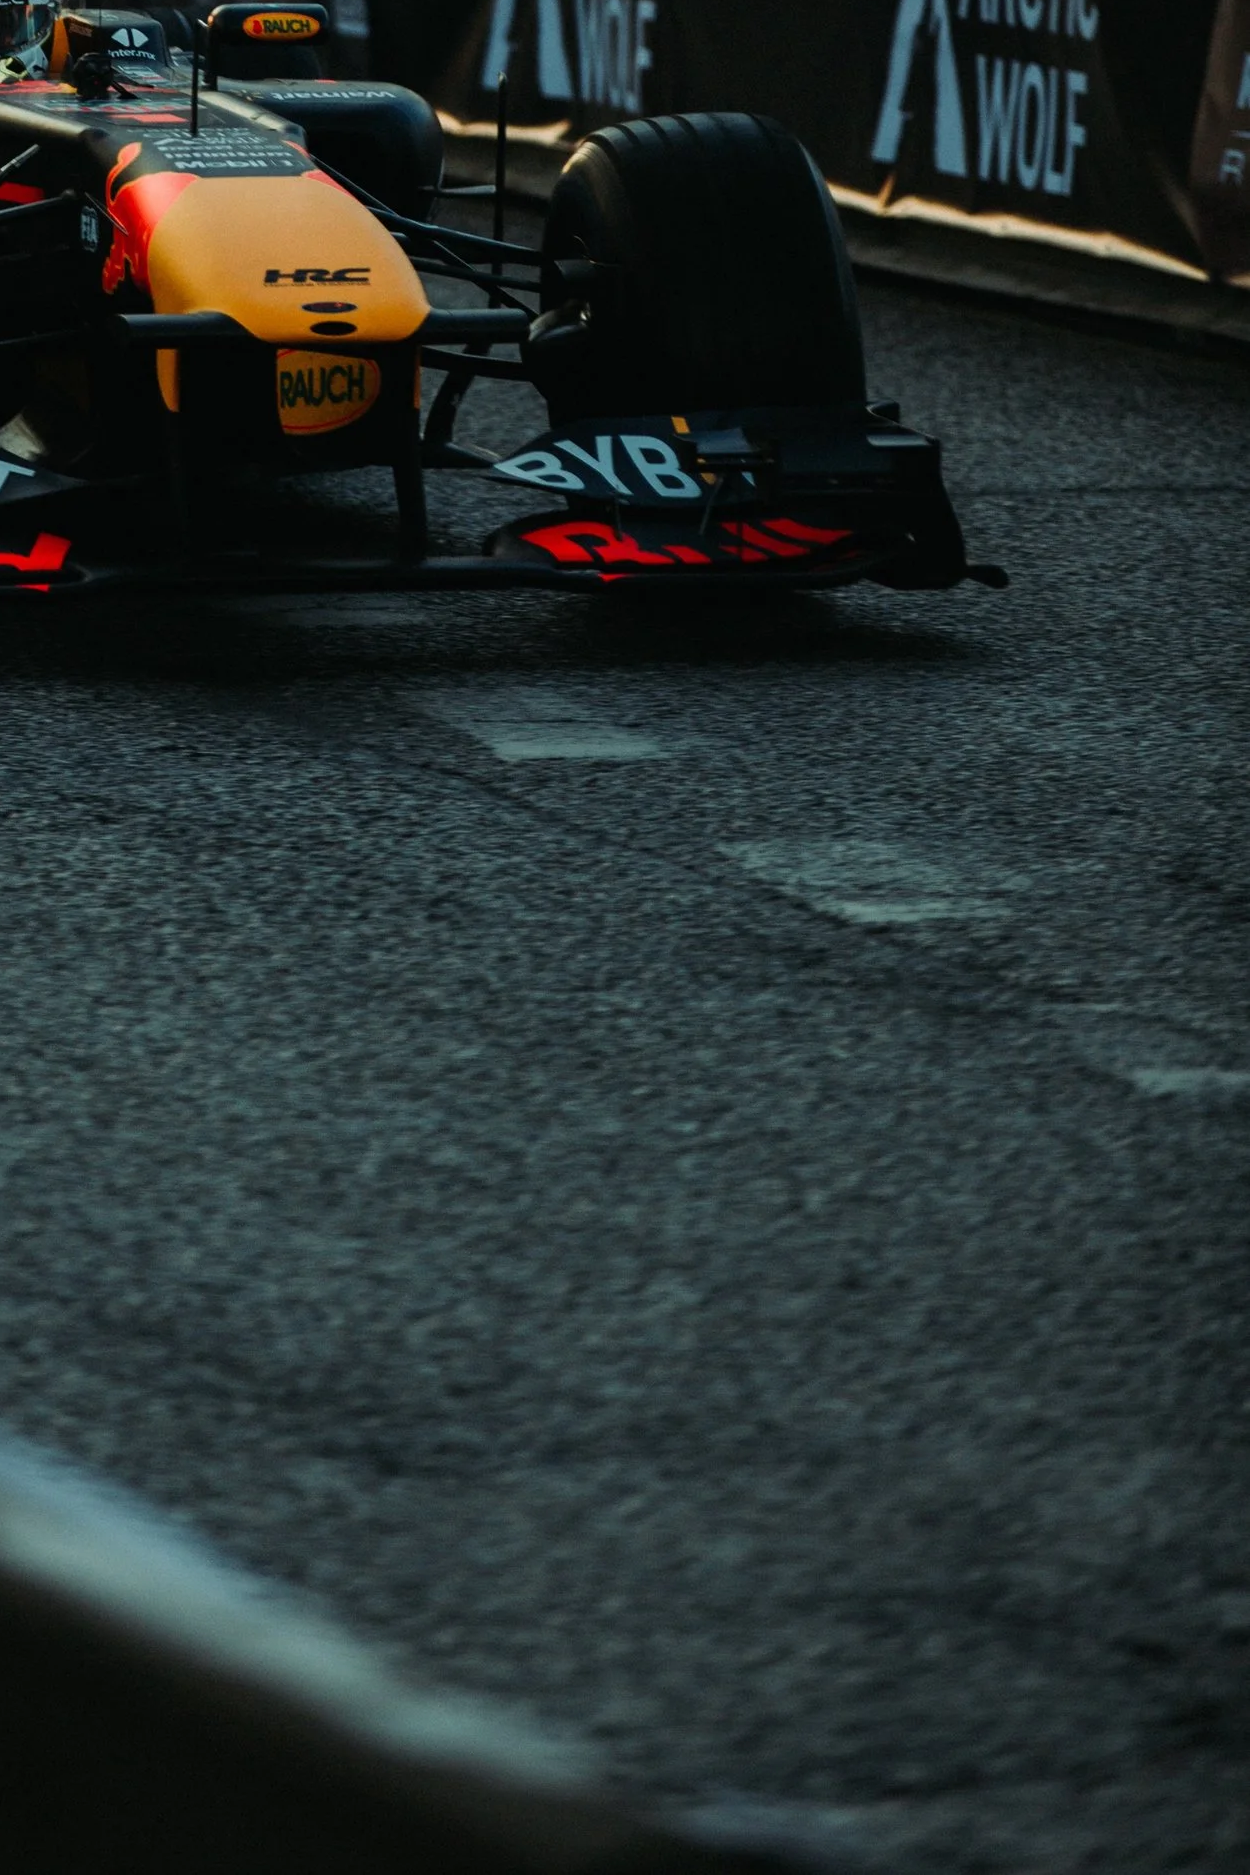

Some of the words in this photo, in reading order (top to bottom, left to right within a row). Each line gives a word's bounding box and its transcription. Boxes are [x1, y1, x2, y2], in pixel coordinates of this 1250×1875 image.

[262, 19, 310, 33] RAUCH
[270, 88, 397, 100] Walmart
[975, 54, 1088, 198] WOLF
[174, 159, 268, 169] Mobil
[264, 267, 371, 283] HRC
[280, 365, 366, 408] RAUCH
[493, 416, 717, 500] BYB
